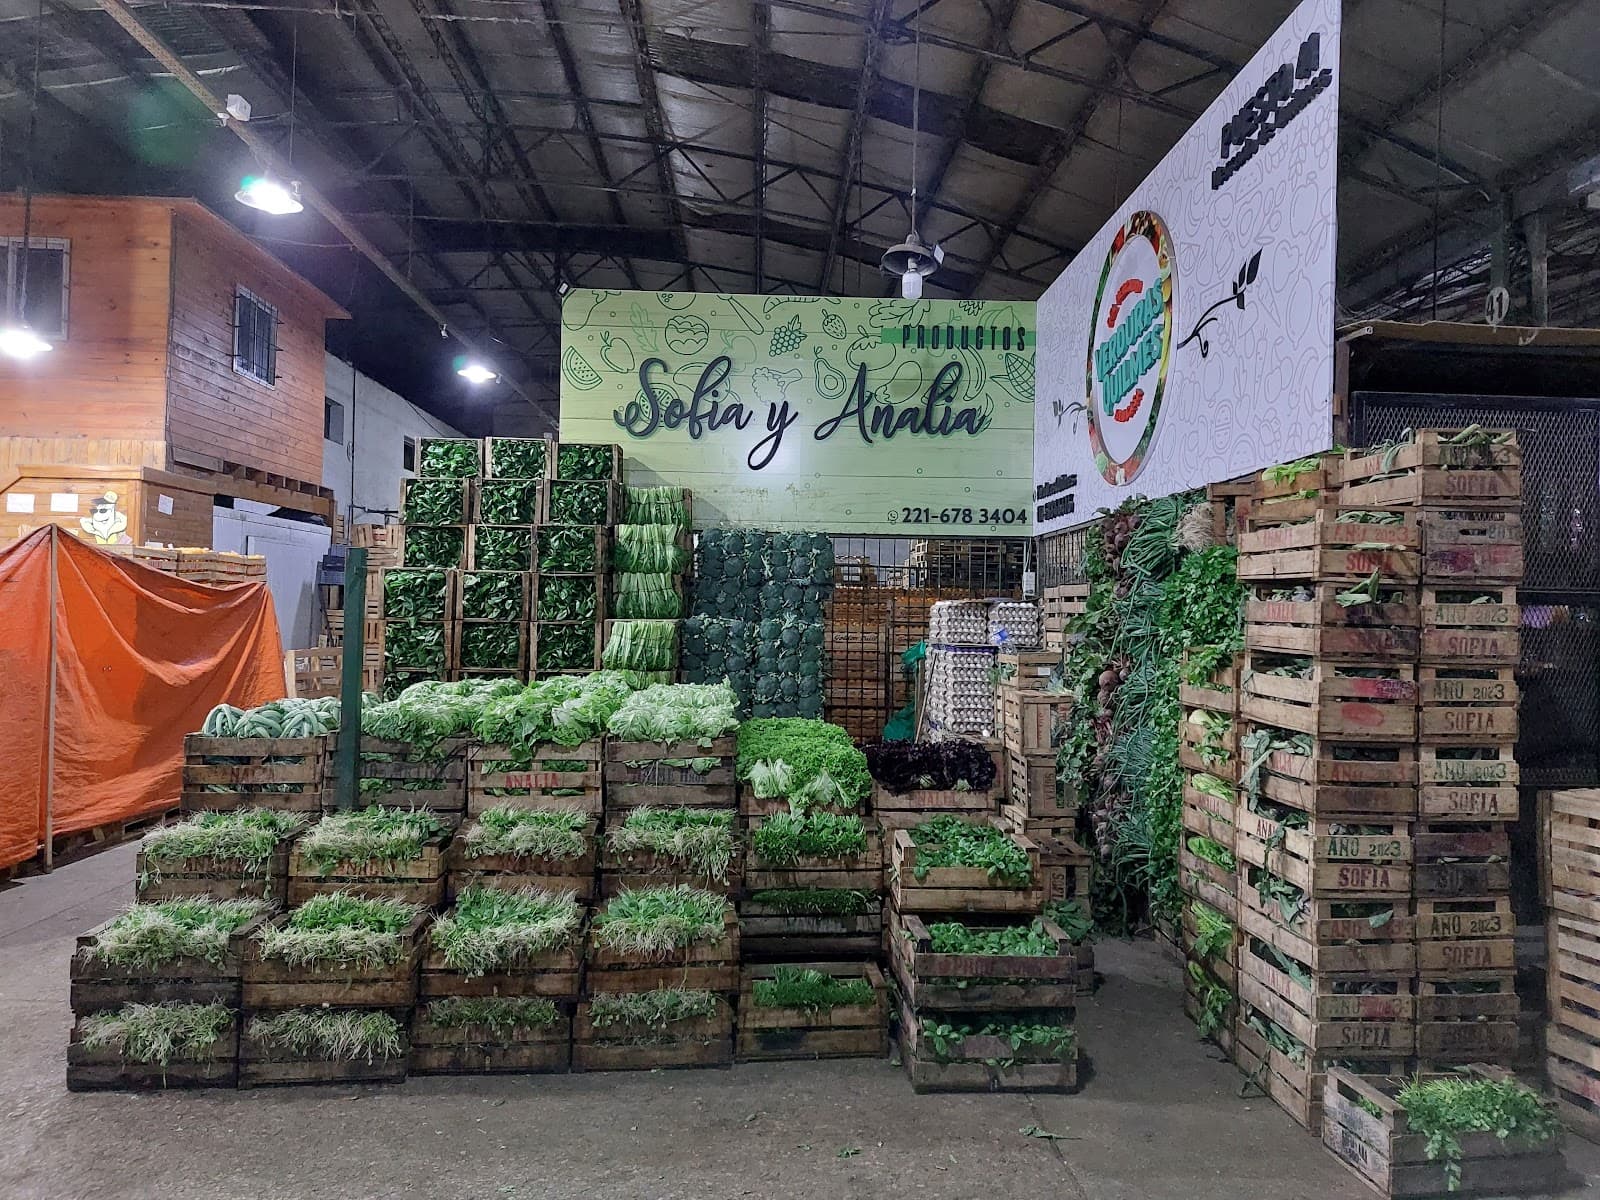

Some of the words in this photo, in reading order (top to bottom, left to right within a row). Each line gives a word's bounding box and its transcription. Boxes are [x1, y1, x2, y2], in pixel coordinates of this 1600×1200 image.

[902, 326, 1026, 350] PRODUCTOS
[1095, 278, 1164, 382] VERDURAS
[1102, 324, 1164, 416] QUILMES
[613, 356, 753, 439] Sofia
[748, 400, 799, 470] y
[814, 361, 988, 443] Analia
[1445, 474, 1499, 495] SOFIA
[902, 507, 973, 525] 221-678
[978, 507, 1028, 525] 3404
[1448, 636, 1498, 656] SOFIA
[1473, 683, 1505, 699] 2023
[1445, 711, 1494, 731] SOFIA
[505, 773, 561, 788] ANALIA
[1448, 791, 1499, 813] SOFIA
[1369, 841, 1401, 857] 2023
[1338, 867, 1390, 888] SOFIA
[1470, 916, 1502, 934] 2023
[1442, 946, 1492, 966] SOFIA
[1341, 1026, 1392, 1046] SOFIA
